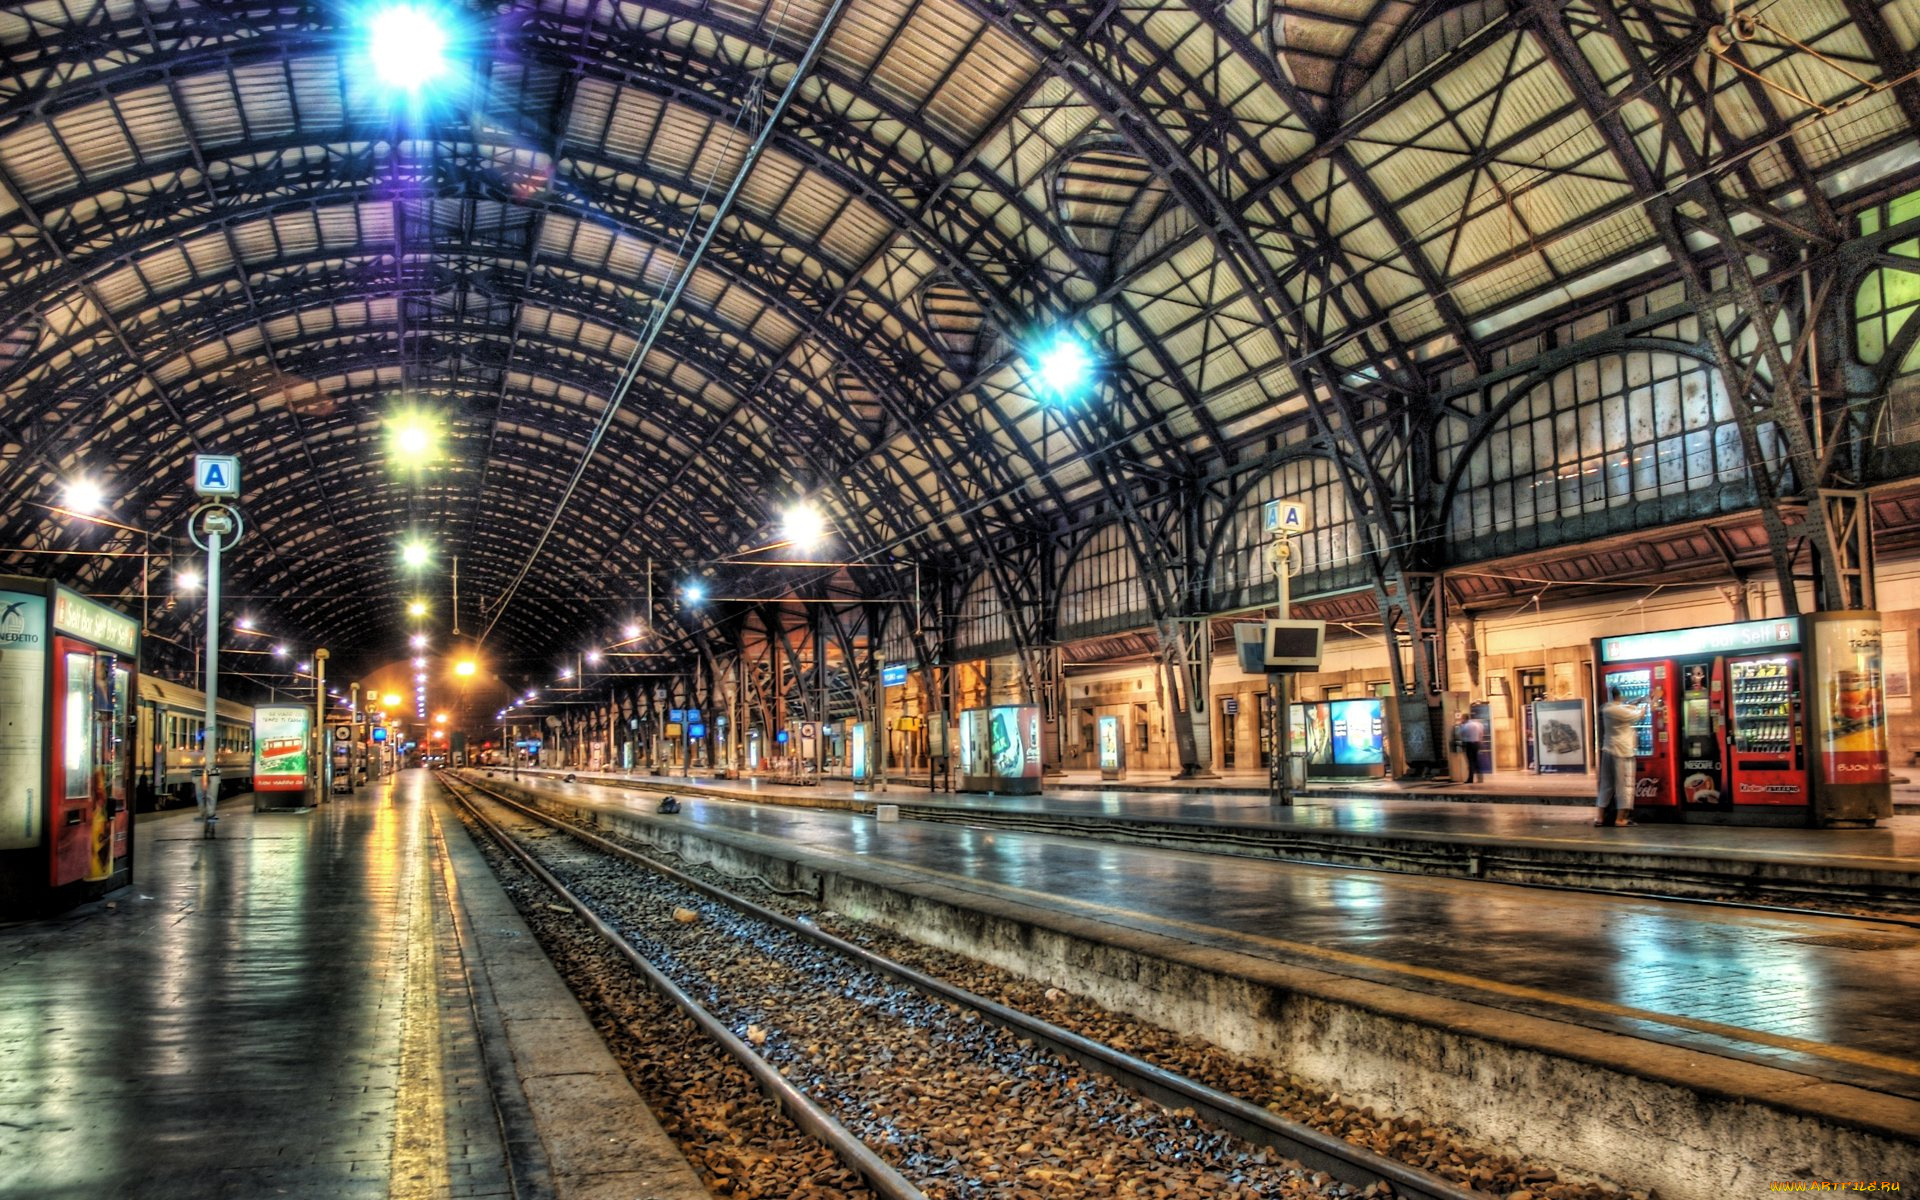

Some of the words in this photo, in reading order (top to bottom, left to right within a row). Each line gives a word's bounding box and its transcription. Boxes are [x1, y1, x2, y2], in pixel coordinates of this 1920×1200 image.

[204, 464, 225, 485] A
[1269, 508, 1276, 525] A
[1286, 507, 1299, 525] A
[1742, 625, 1771, 644] Self
